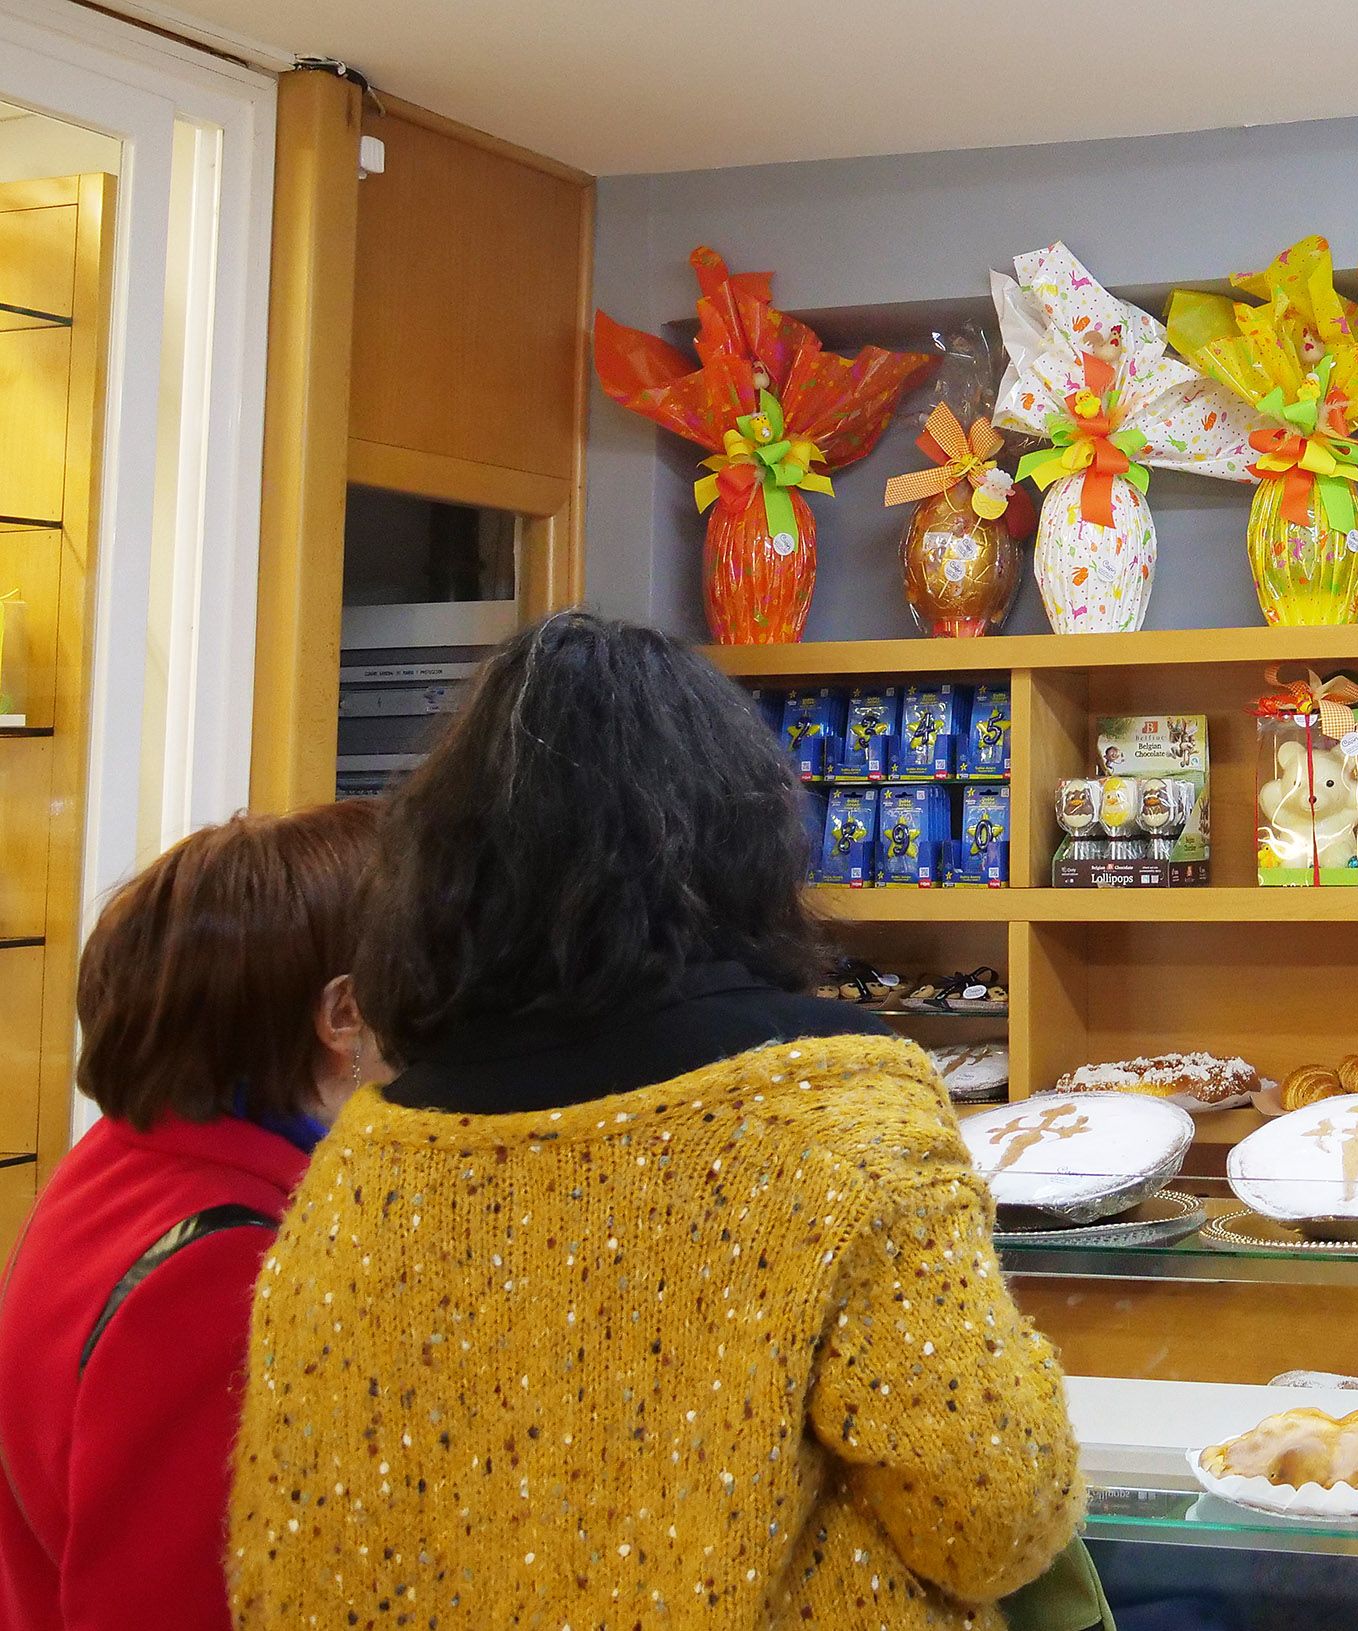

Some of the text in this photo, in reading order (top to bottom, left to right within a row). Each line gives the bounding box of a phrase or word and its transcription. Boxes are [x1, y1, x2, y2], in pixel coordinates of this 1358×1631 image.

[1139, 743, 1162, 751] Belgian
[1135, 750, 1166, 758] Chocolate
[1091, 873, 1134, 885] Lollipops
